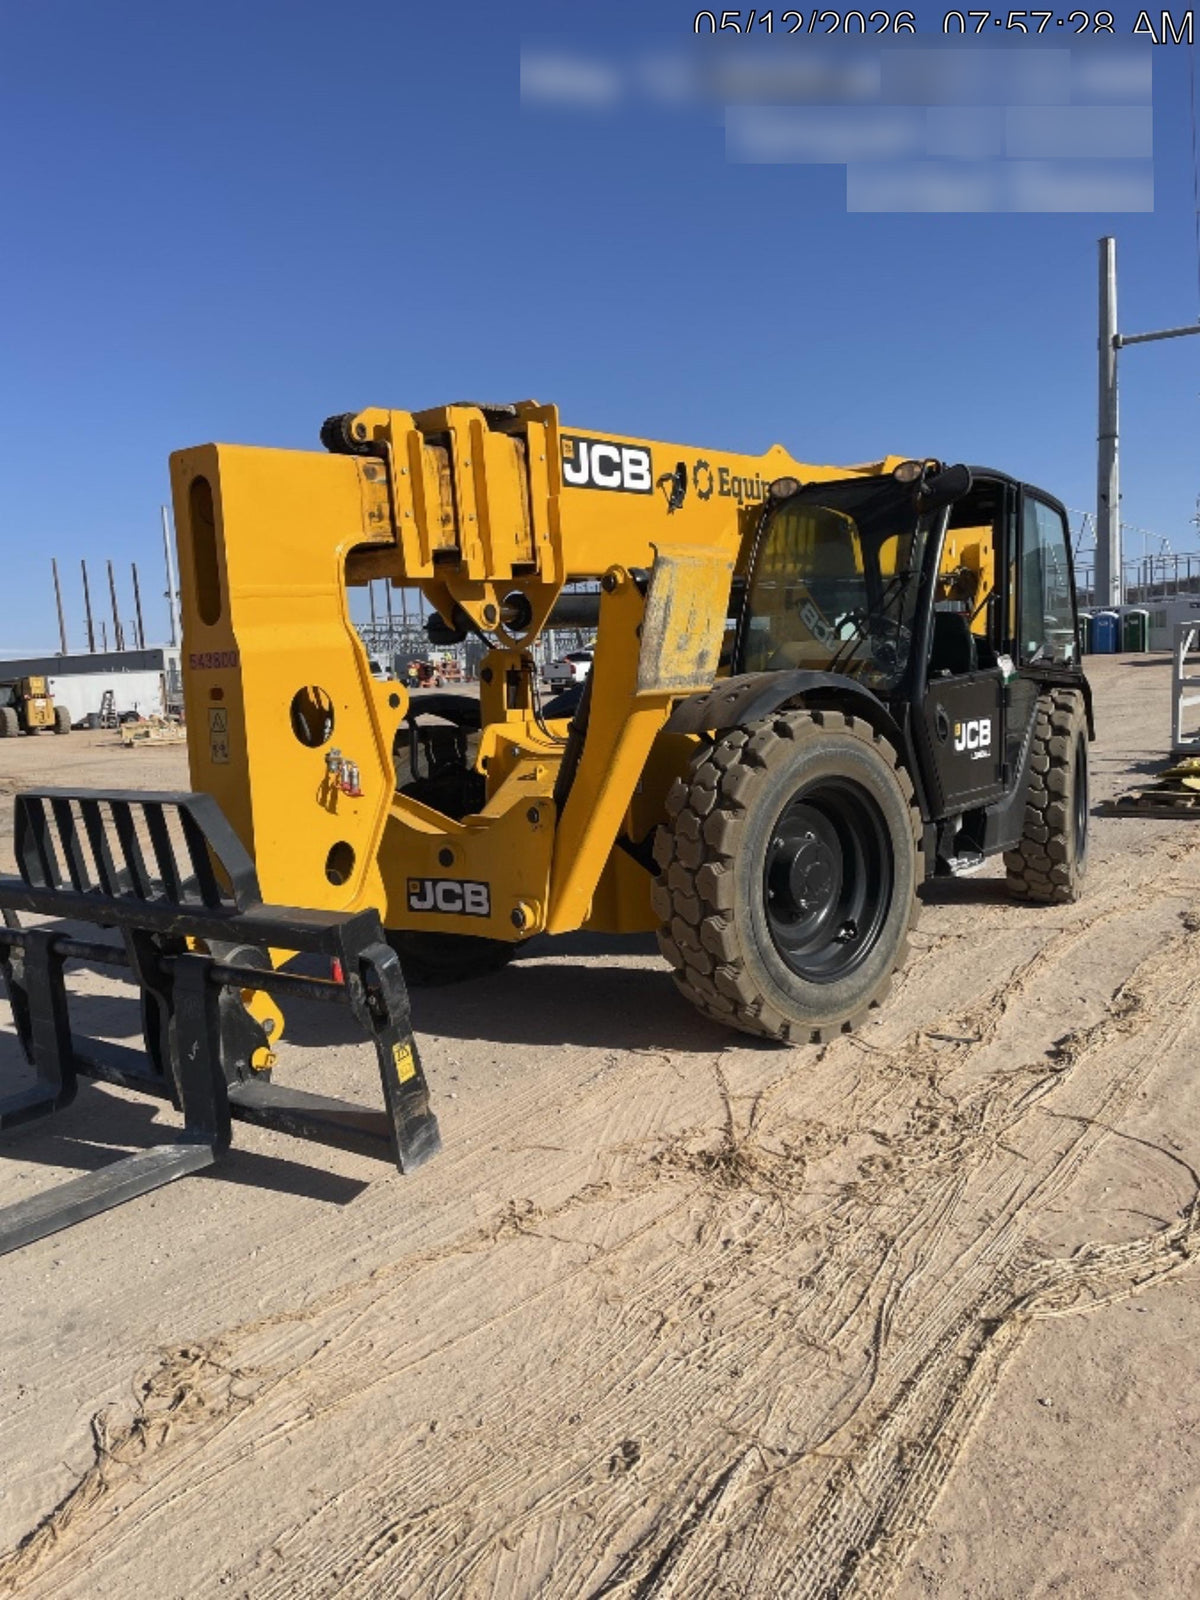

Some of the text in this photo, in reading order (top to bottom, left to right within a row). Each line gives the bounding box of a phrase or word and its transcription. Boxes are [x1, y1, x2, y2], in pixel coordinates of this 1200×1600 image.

[563, 441, 651, 490] JCB
[954, 719, 991, 751] JCB
[410, 881, 490, 915] JCB
